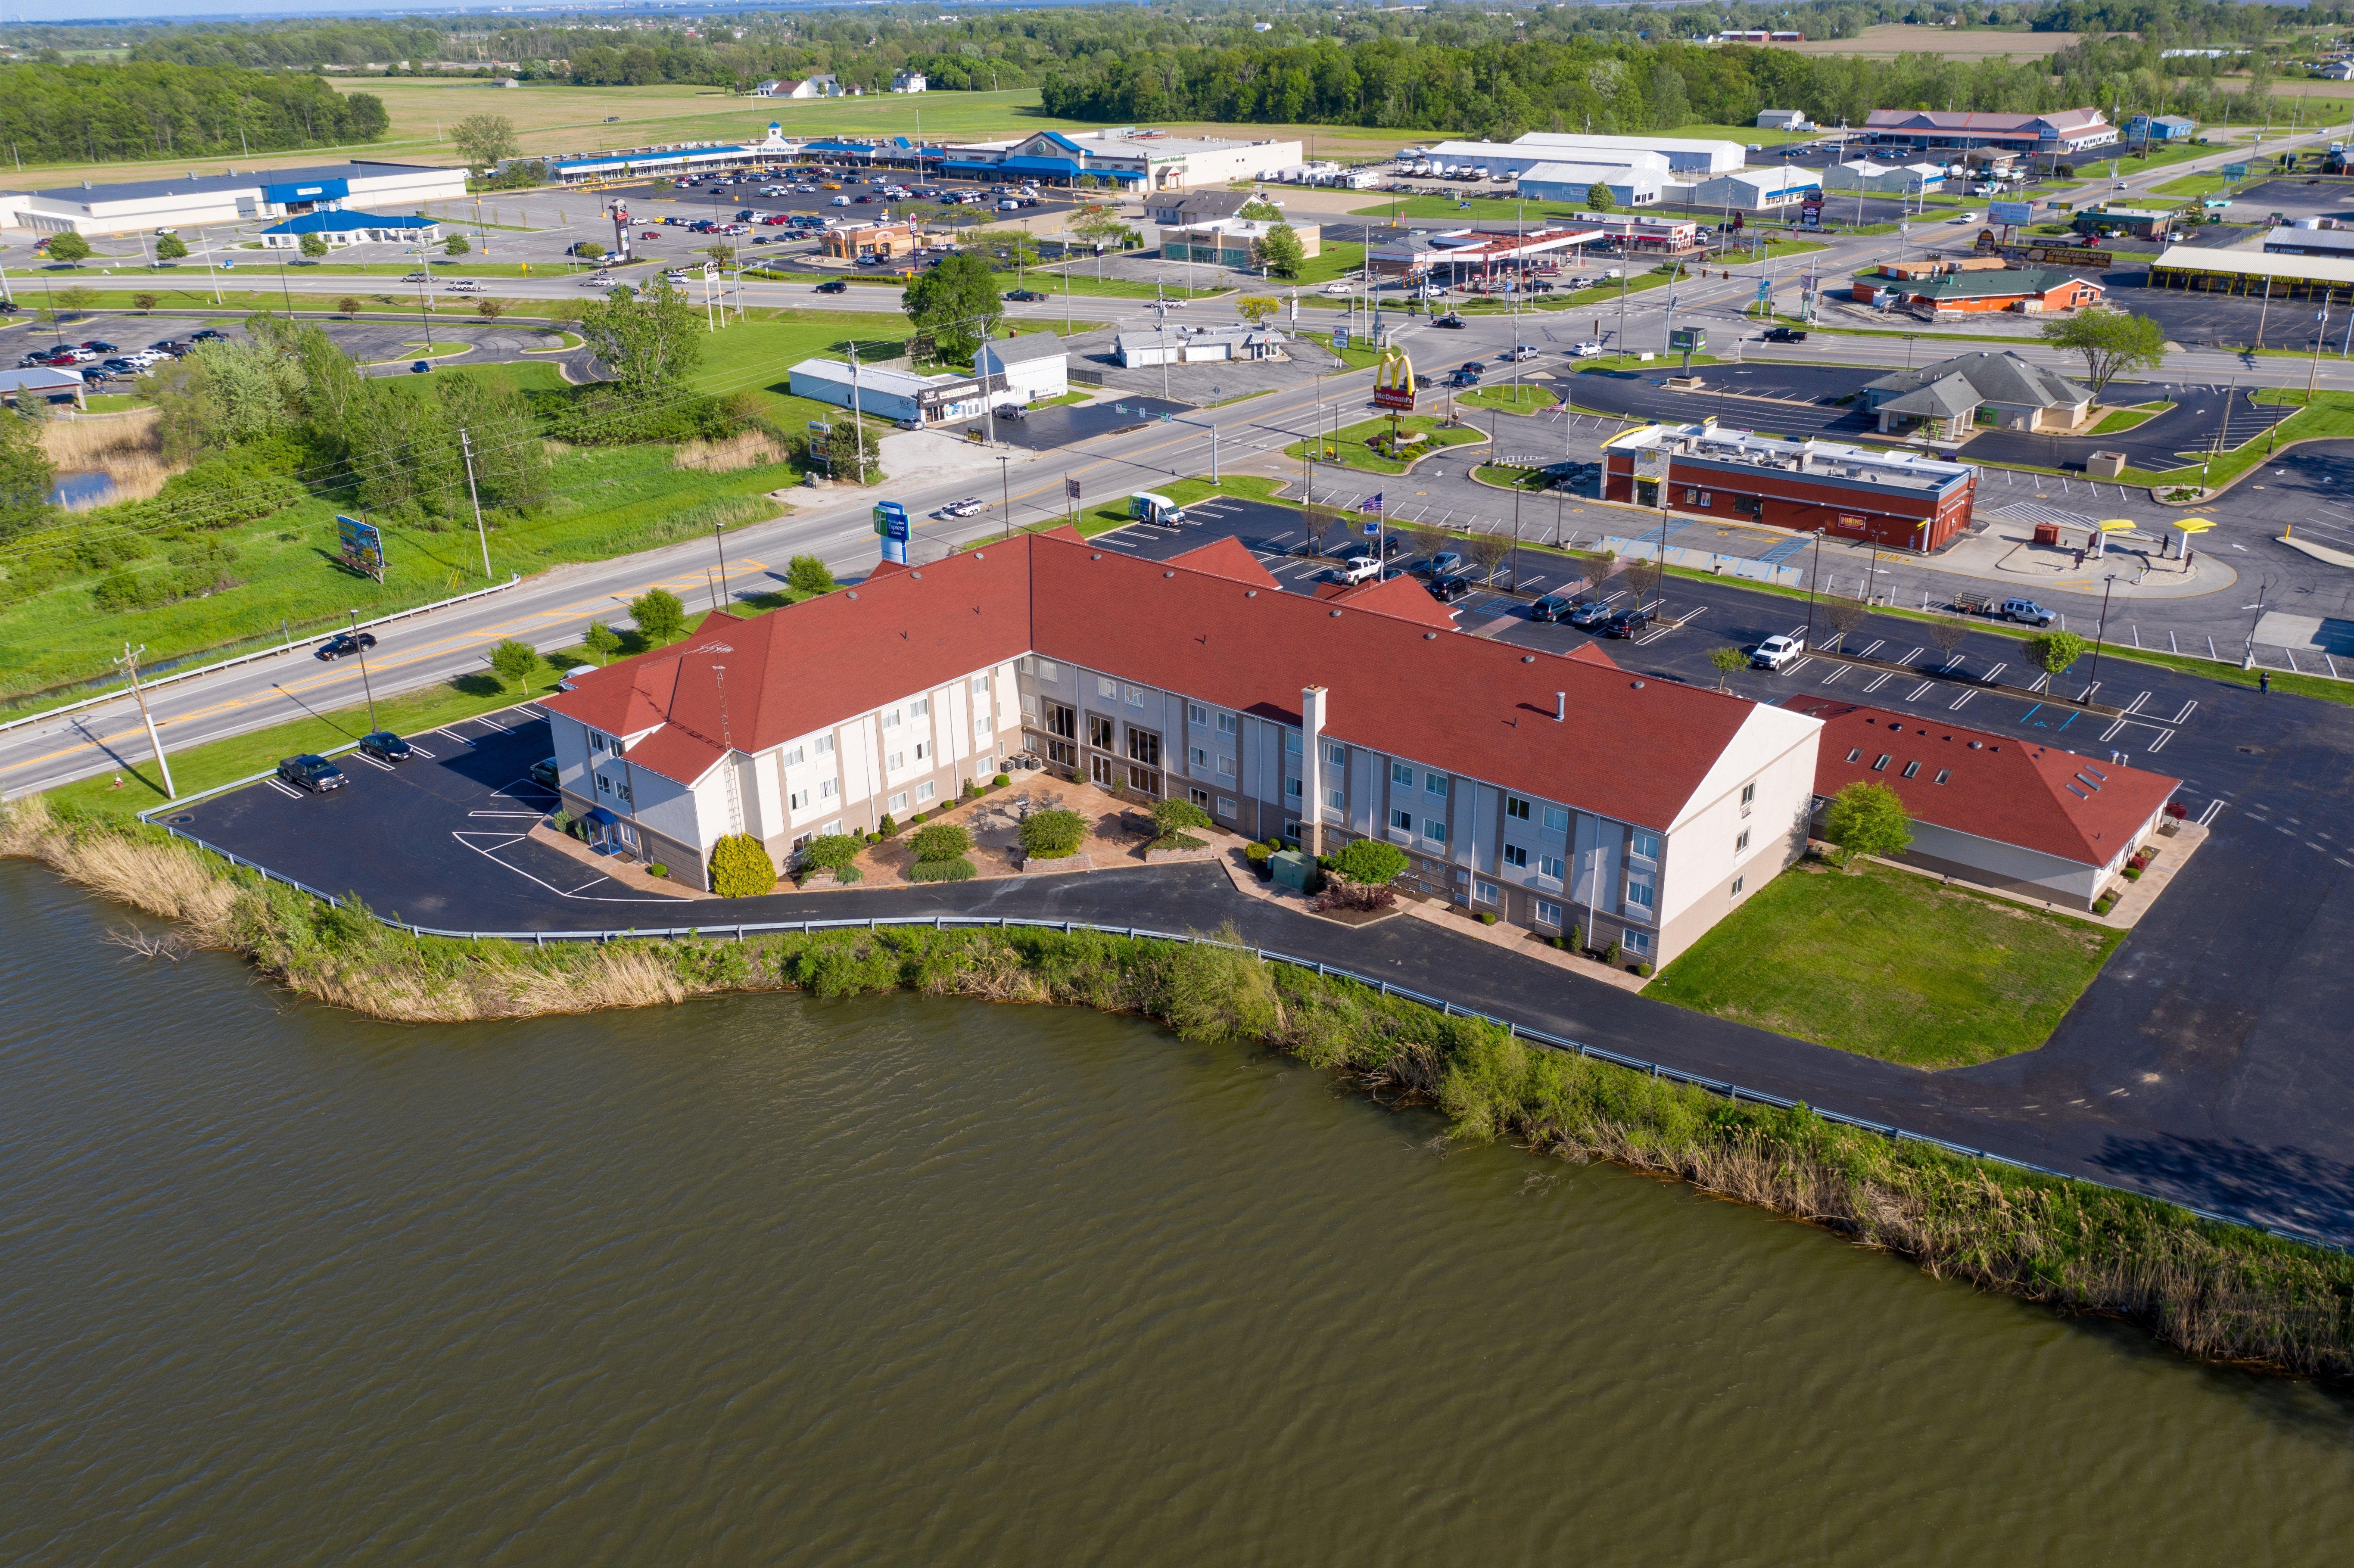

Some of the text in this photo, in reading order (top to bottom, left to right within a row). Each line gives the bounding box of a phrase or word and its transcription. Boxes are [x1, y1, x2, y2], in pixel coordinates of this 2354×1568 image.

[2047, 249, 2110, 260] CHEESEHAVEN
[2245, 272, 2304, 285] CHEEEHAVEN
[1376, 392, 1412, 404] McDonald's
[1841, 516, 1864, 526] HIRING
[888, 523, 905, 531] Express
